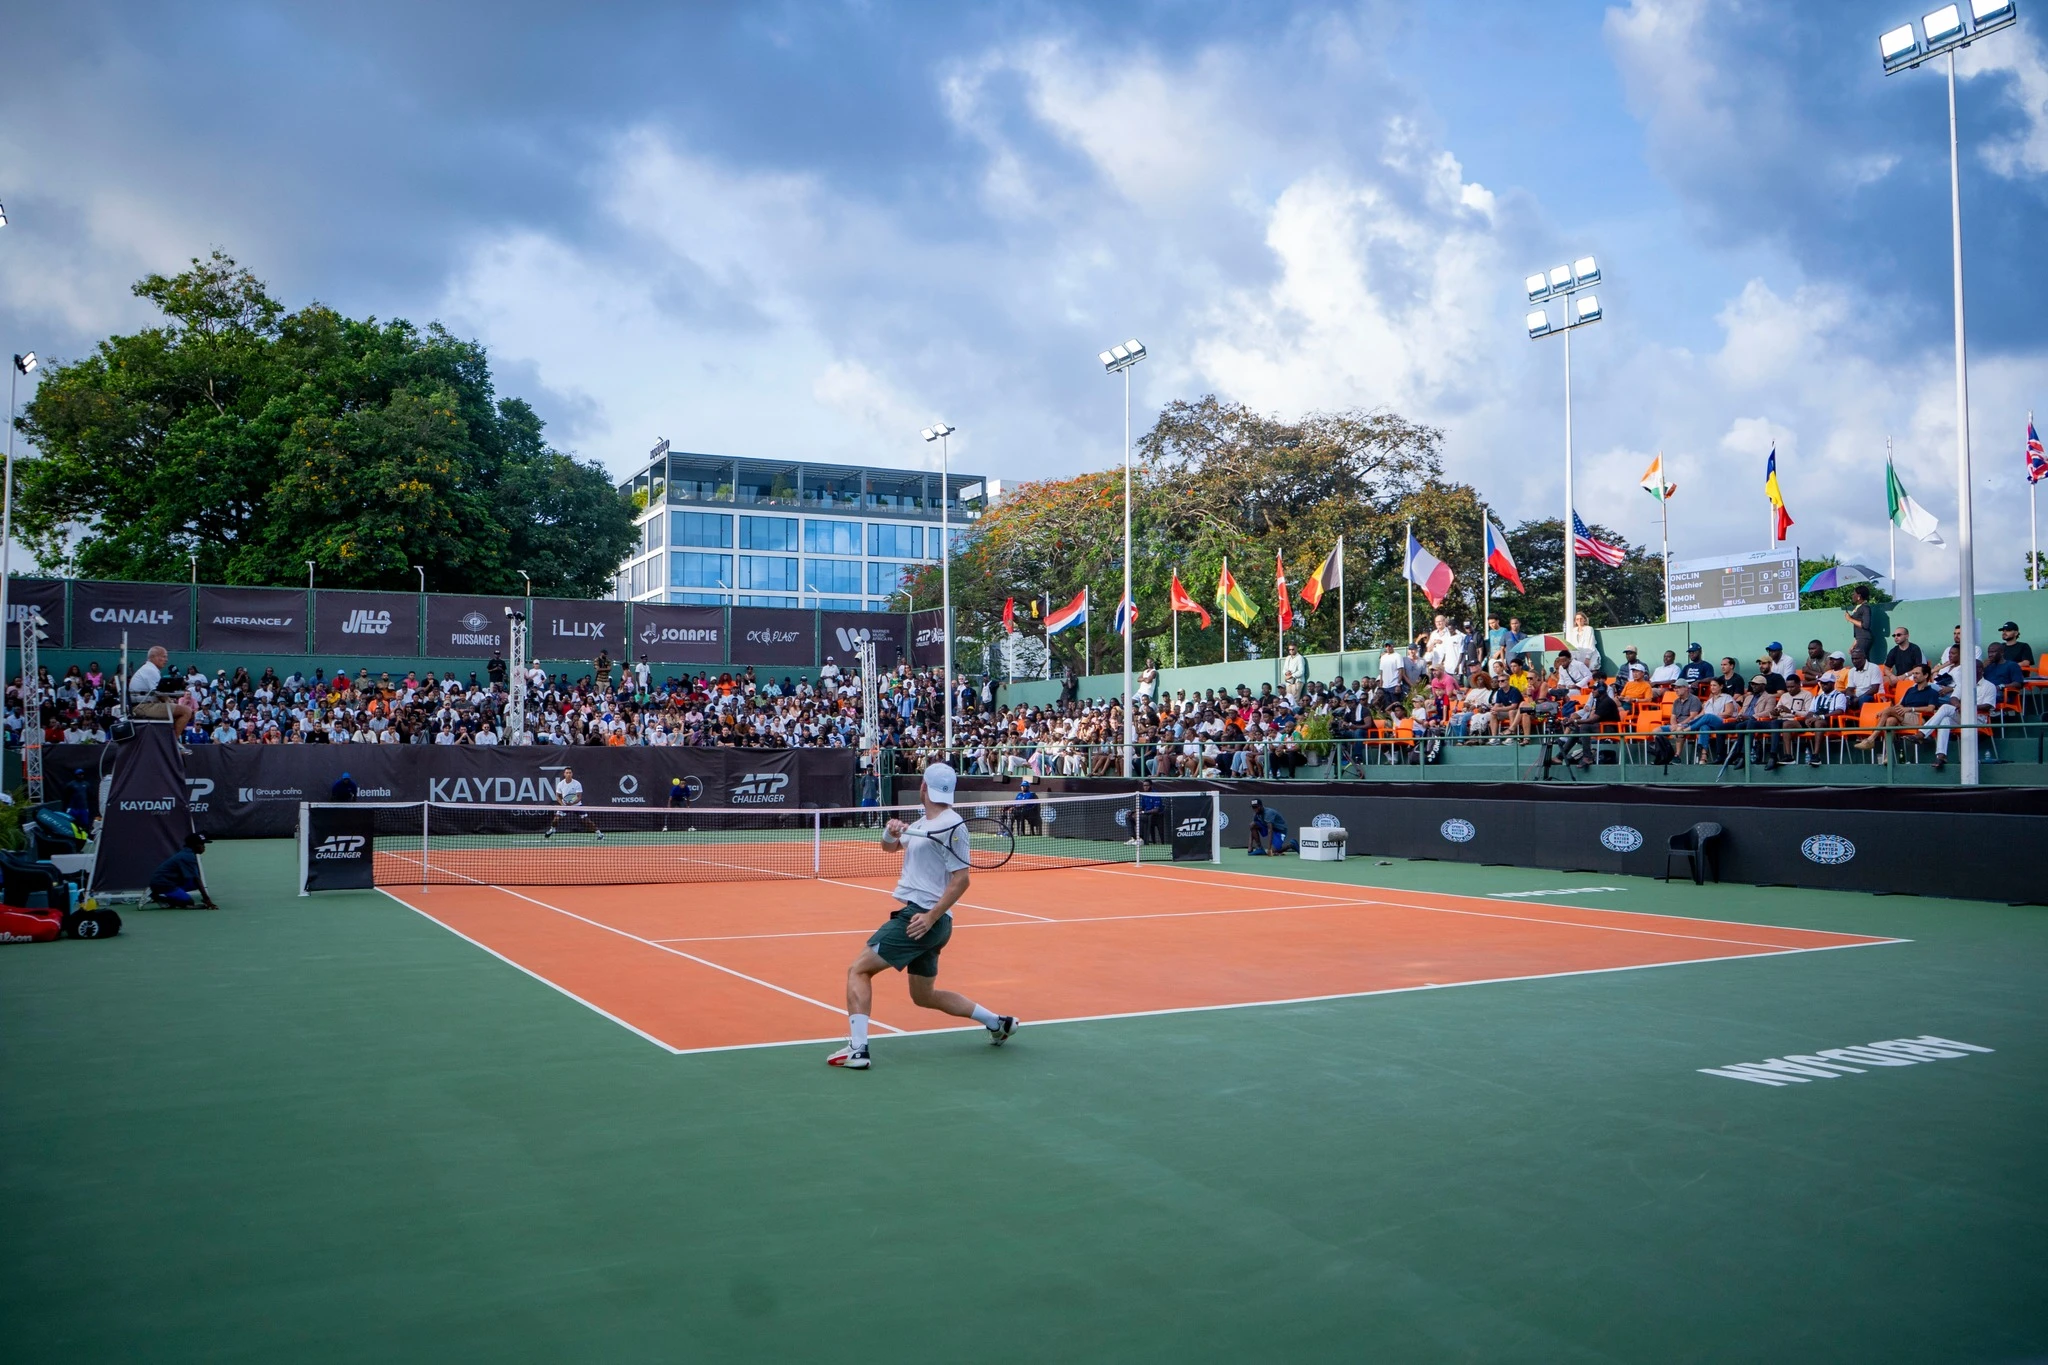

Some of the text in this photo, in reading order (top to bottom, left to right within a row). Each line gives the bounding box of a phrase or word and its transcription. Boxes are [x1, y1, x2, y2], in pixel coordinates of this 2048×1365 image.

[1670, 572, 1700, 582] ONCLIN
[1780, 570, 1791, 578] 30
[1670, 582, 1704, 591] Gauthier
[1671, 594, 1696, 603] MMOH
[1671, 603, 1701, 611] Michael
[90, 607, 174, 625] CANAL+
[451, 633, 500, 646] PUISSANCE 6
[661, 628, 718, 642] SONAPIE
[746, 630, 800, 644] OK PLAST
[729, 773, 789, 795] ATP
[256, 787, 303, 798] Groupe cofina
[731, 794, 785, 804] CHALLENGER
[120, 801, 172, 811] KAYDAN
[1176, 818, 1207, 831] ATP
[1176, 830, 1205, 838] CHALLENGER
[314, 835, 366, 852] ATP
[315, 851, 362, 859] CHALLENGER
[1696, 1034, 1997, 1087] ABIDJAN
